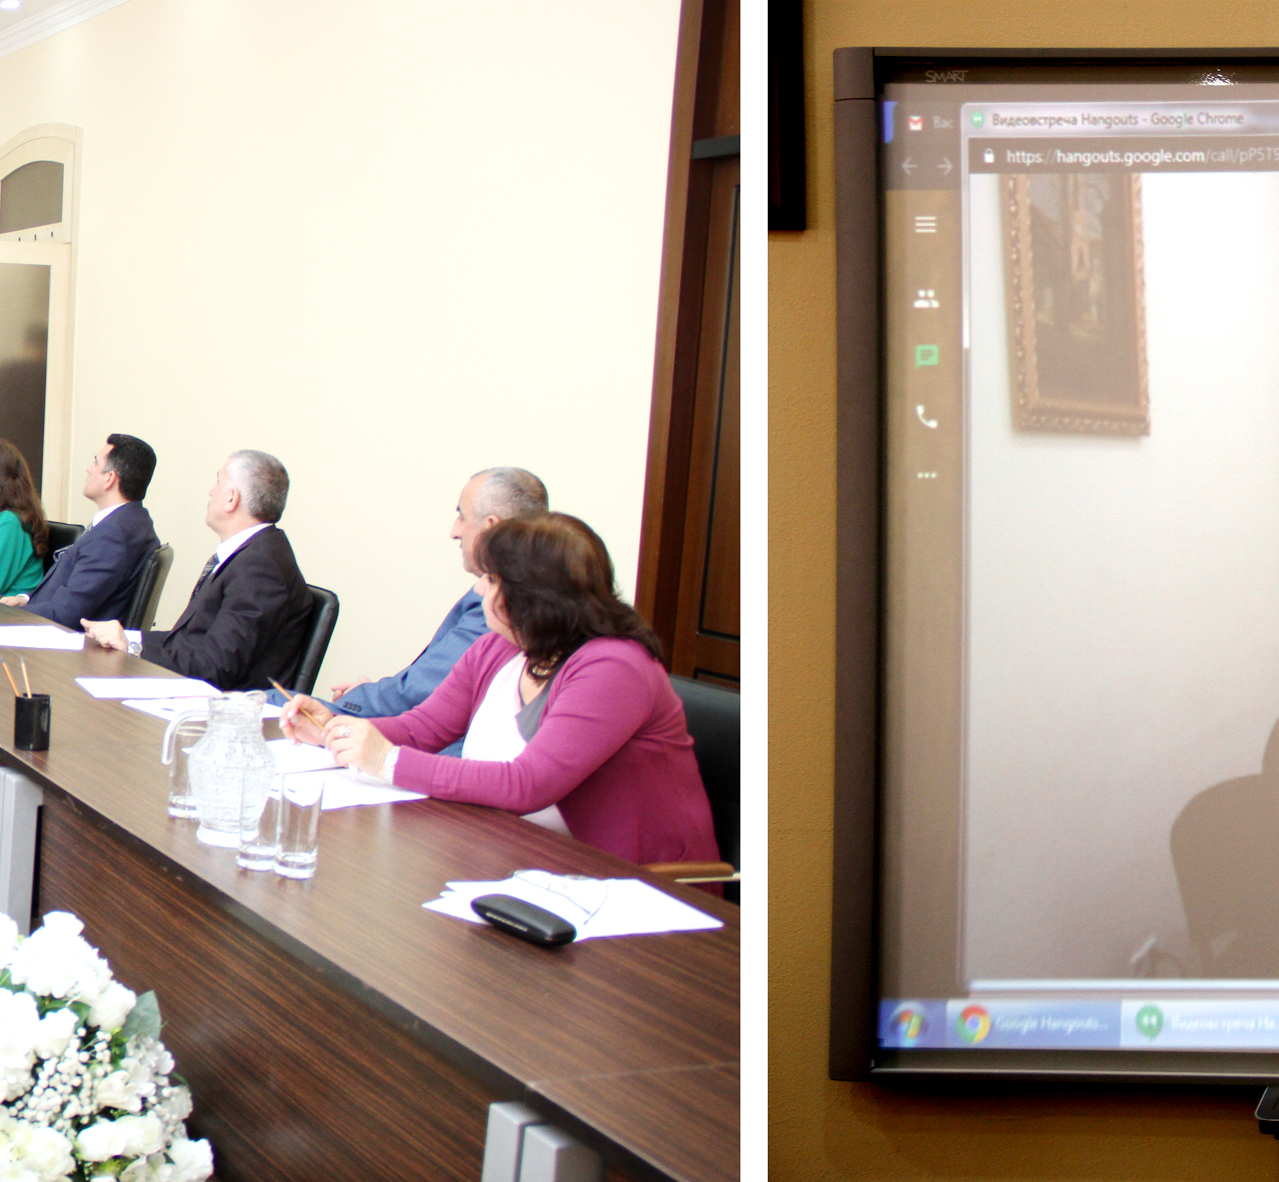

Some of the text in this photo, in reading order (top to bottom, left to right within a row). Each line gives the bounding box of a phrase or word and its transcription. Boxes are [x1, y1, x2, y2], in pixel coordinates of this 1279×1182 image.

[925, 70, 969, 83] SMART
[991, 112, 1078, 130] Видеовстреча
[1081, 113, 1139, 129] Hangouts
[1150, 112, 1194, 128] Google
[1196, 111, 1245, 125] Chrome
